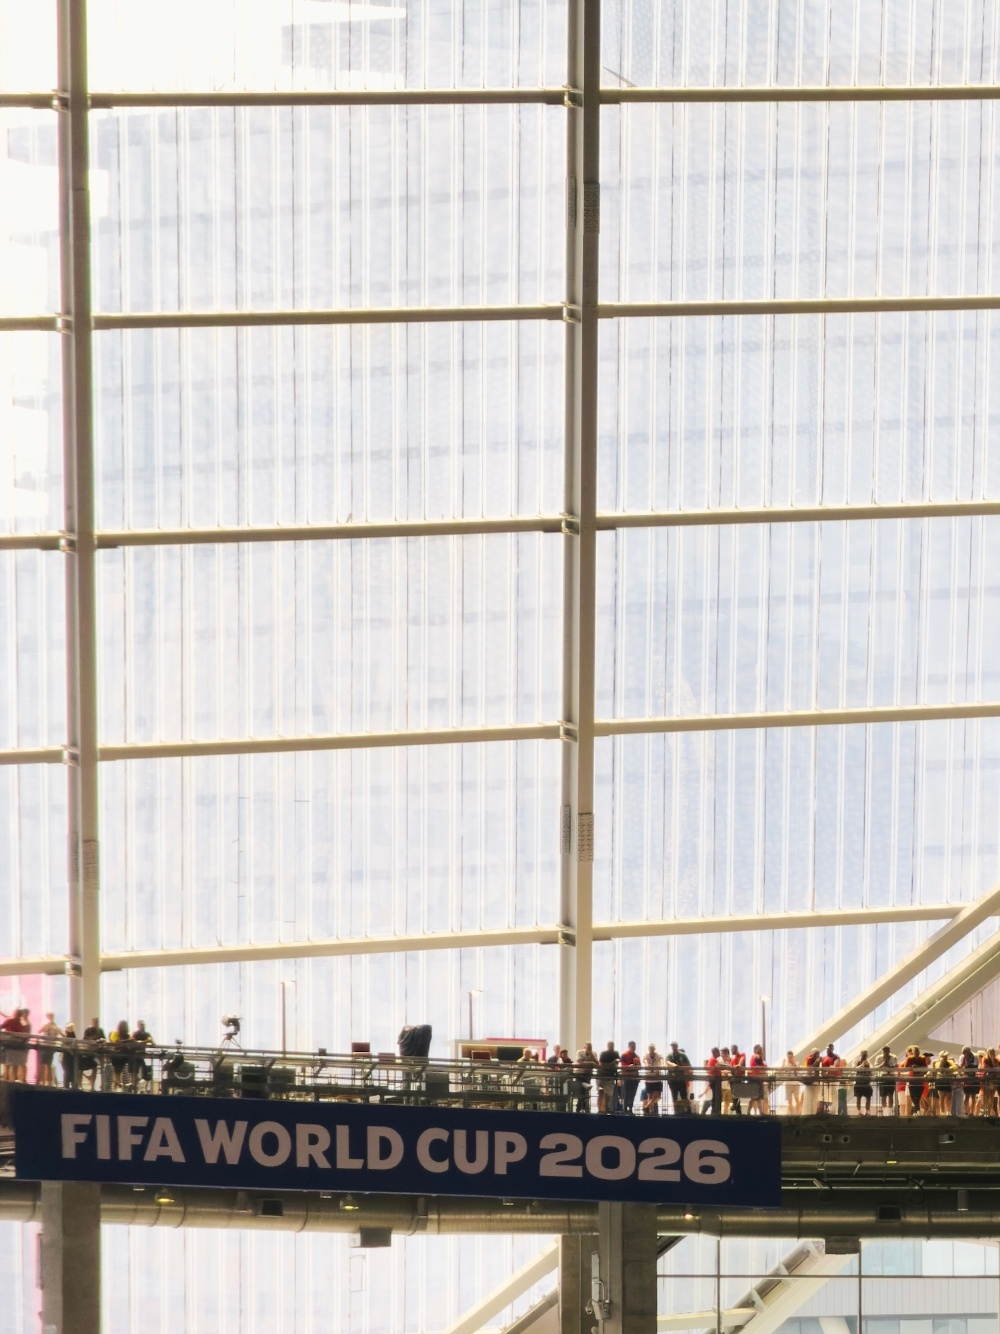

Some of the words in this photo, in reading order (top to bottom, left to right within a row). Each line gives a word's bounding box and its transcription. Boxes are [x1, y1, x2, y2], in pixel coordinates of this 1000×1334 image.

[61, 1113, 186, 1163] FIFA
[194, 1118, 405, 1171] WORLD
[416, 1127, 528, 1175] CUP
[539, 1132, 732, 1185] 2026
